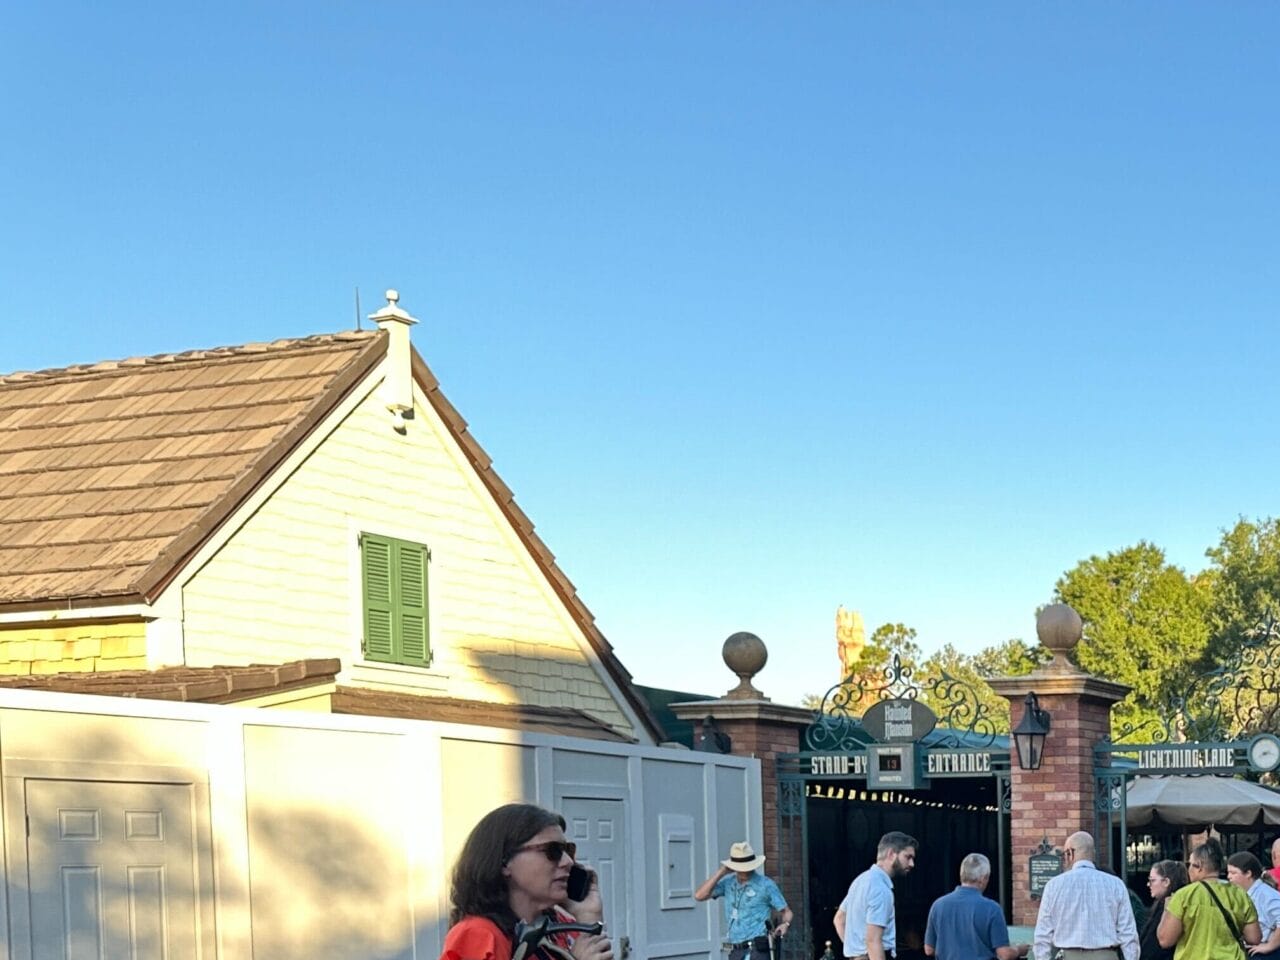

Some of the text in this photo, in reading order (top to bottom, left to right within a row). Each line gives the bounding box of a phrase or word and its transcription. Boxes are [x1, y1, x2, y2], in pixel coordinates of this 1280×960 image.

[811, 753, 991, 775] STAND-BY ENTRANCE
[1138, 750, 1199, 769] LIGHTNING
[1204, 749, 1235, 767] LANE
